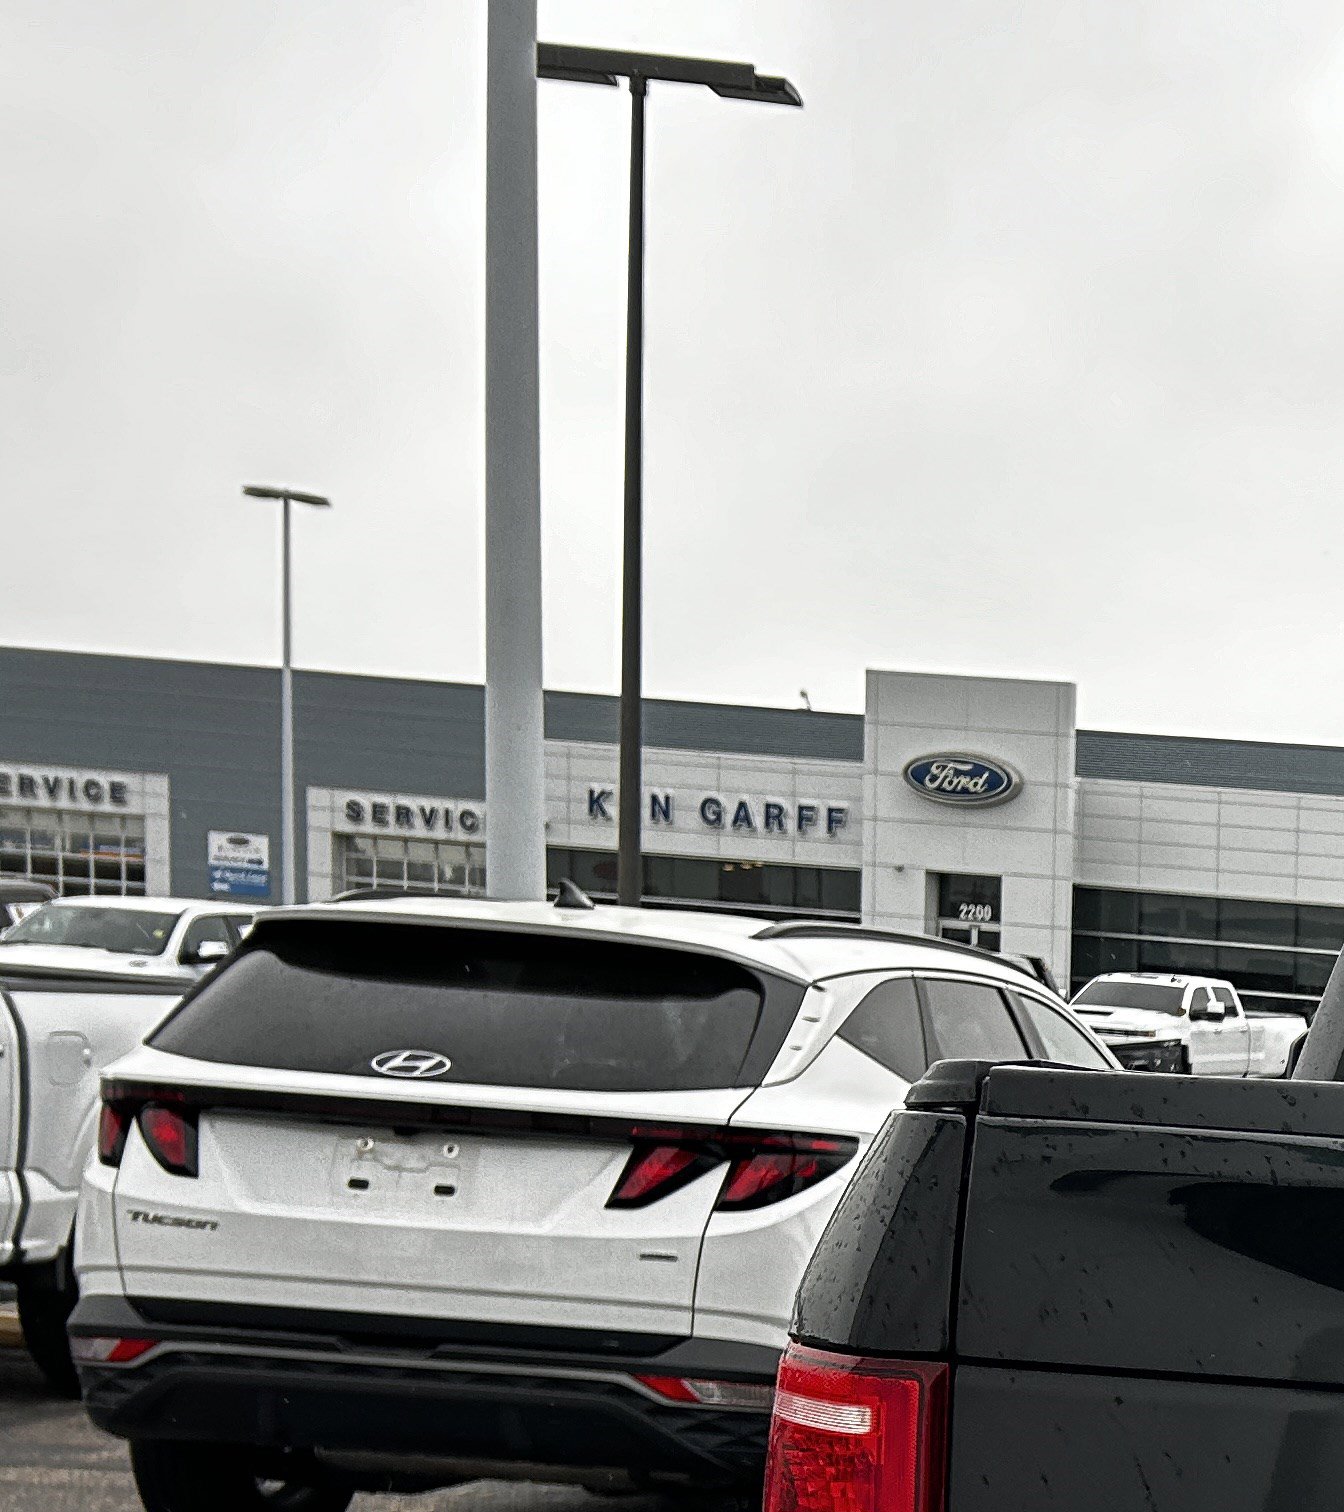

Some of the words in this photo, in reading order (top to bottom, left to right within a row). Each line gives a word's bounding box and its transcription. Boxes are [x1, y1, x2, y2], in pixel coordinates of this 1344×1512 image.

[925, 762, 989, 793] Ford
[588, 787, 673, 825] KN
[700, 797, 847, 837] GARFF
[959, 903, 992, 921] 2200
